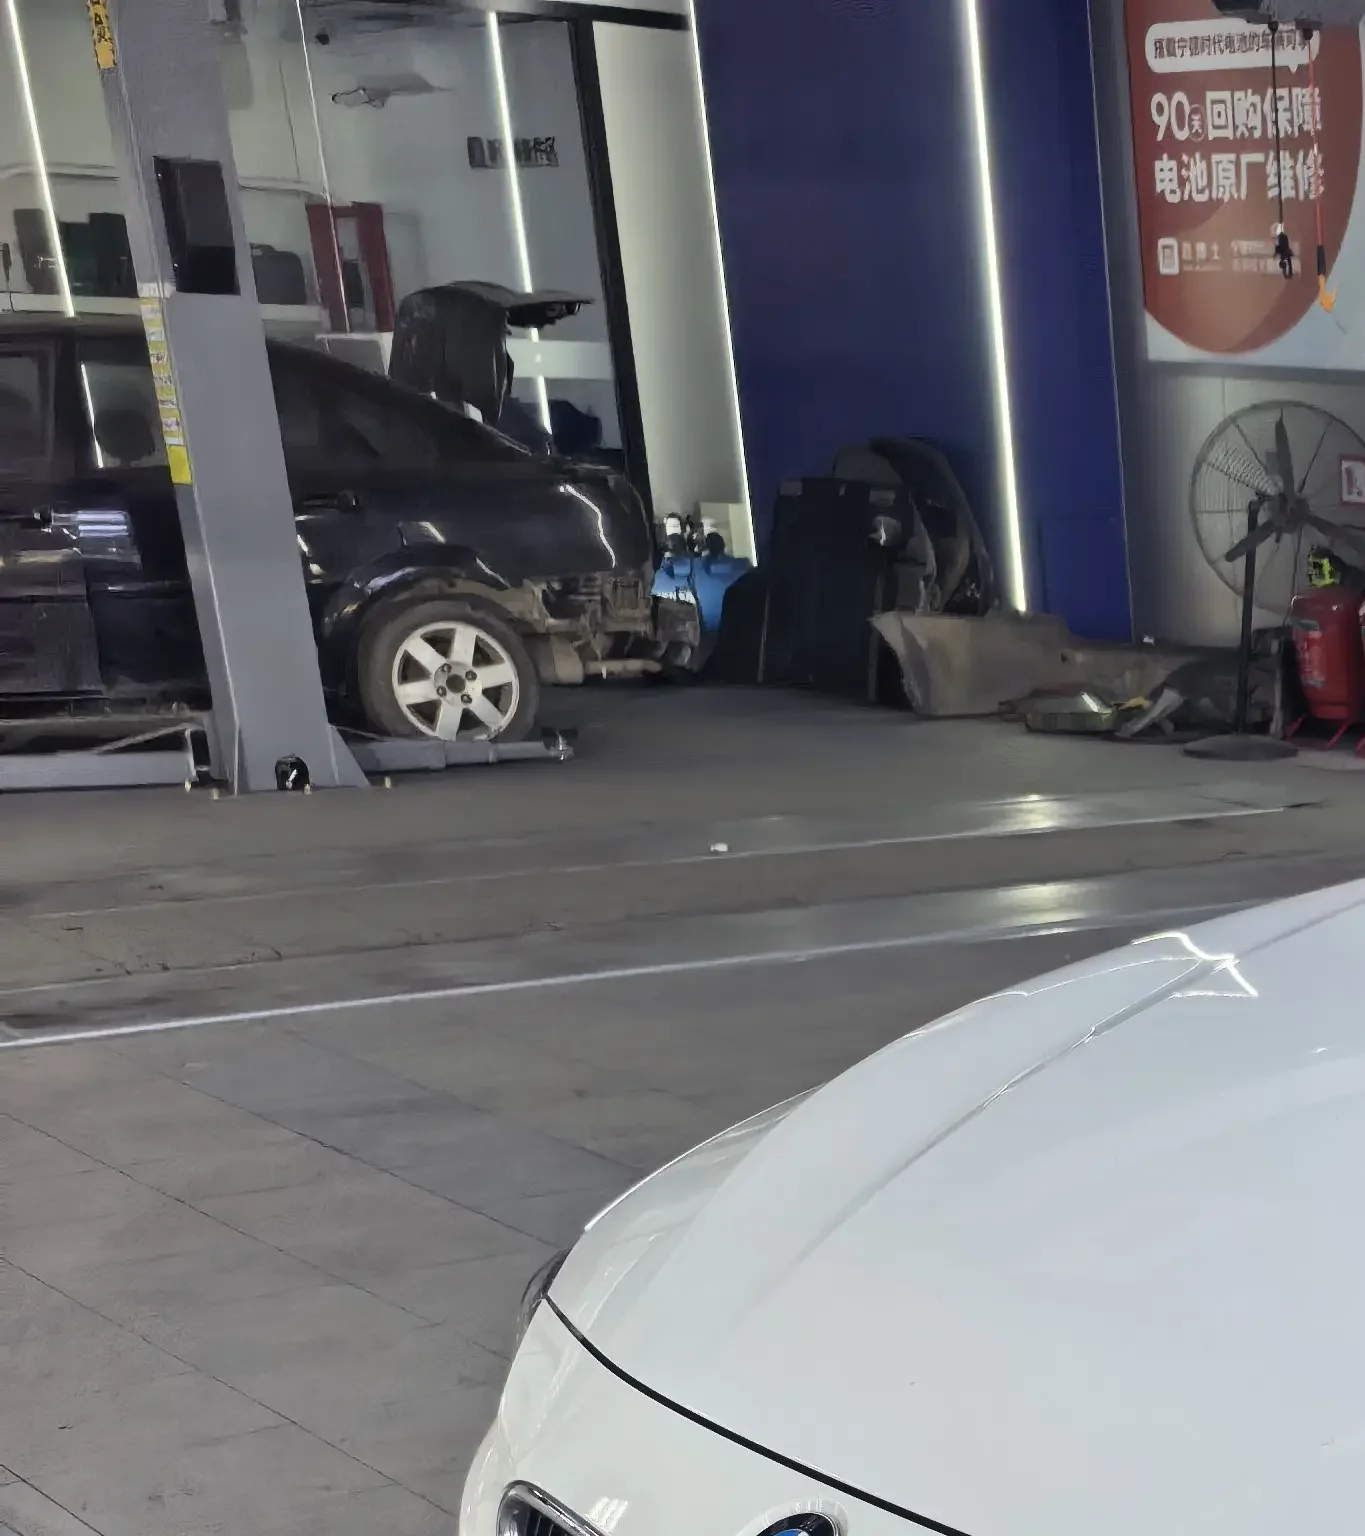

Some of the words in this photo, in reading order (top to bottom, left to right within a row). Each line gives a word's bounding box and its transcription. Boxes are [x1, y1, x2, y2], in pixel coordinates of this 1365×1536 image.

[1155, 148, 1325, 203] 电池原厂维修
